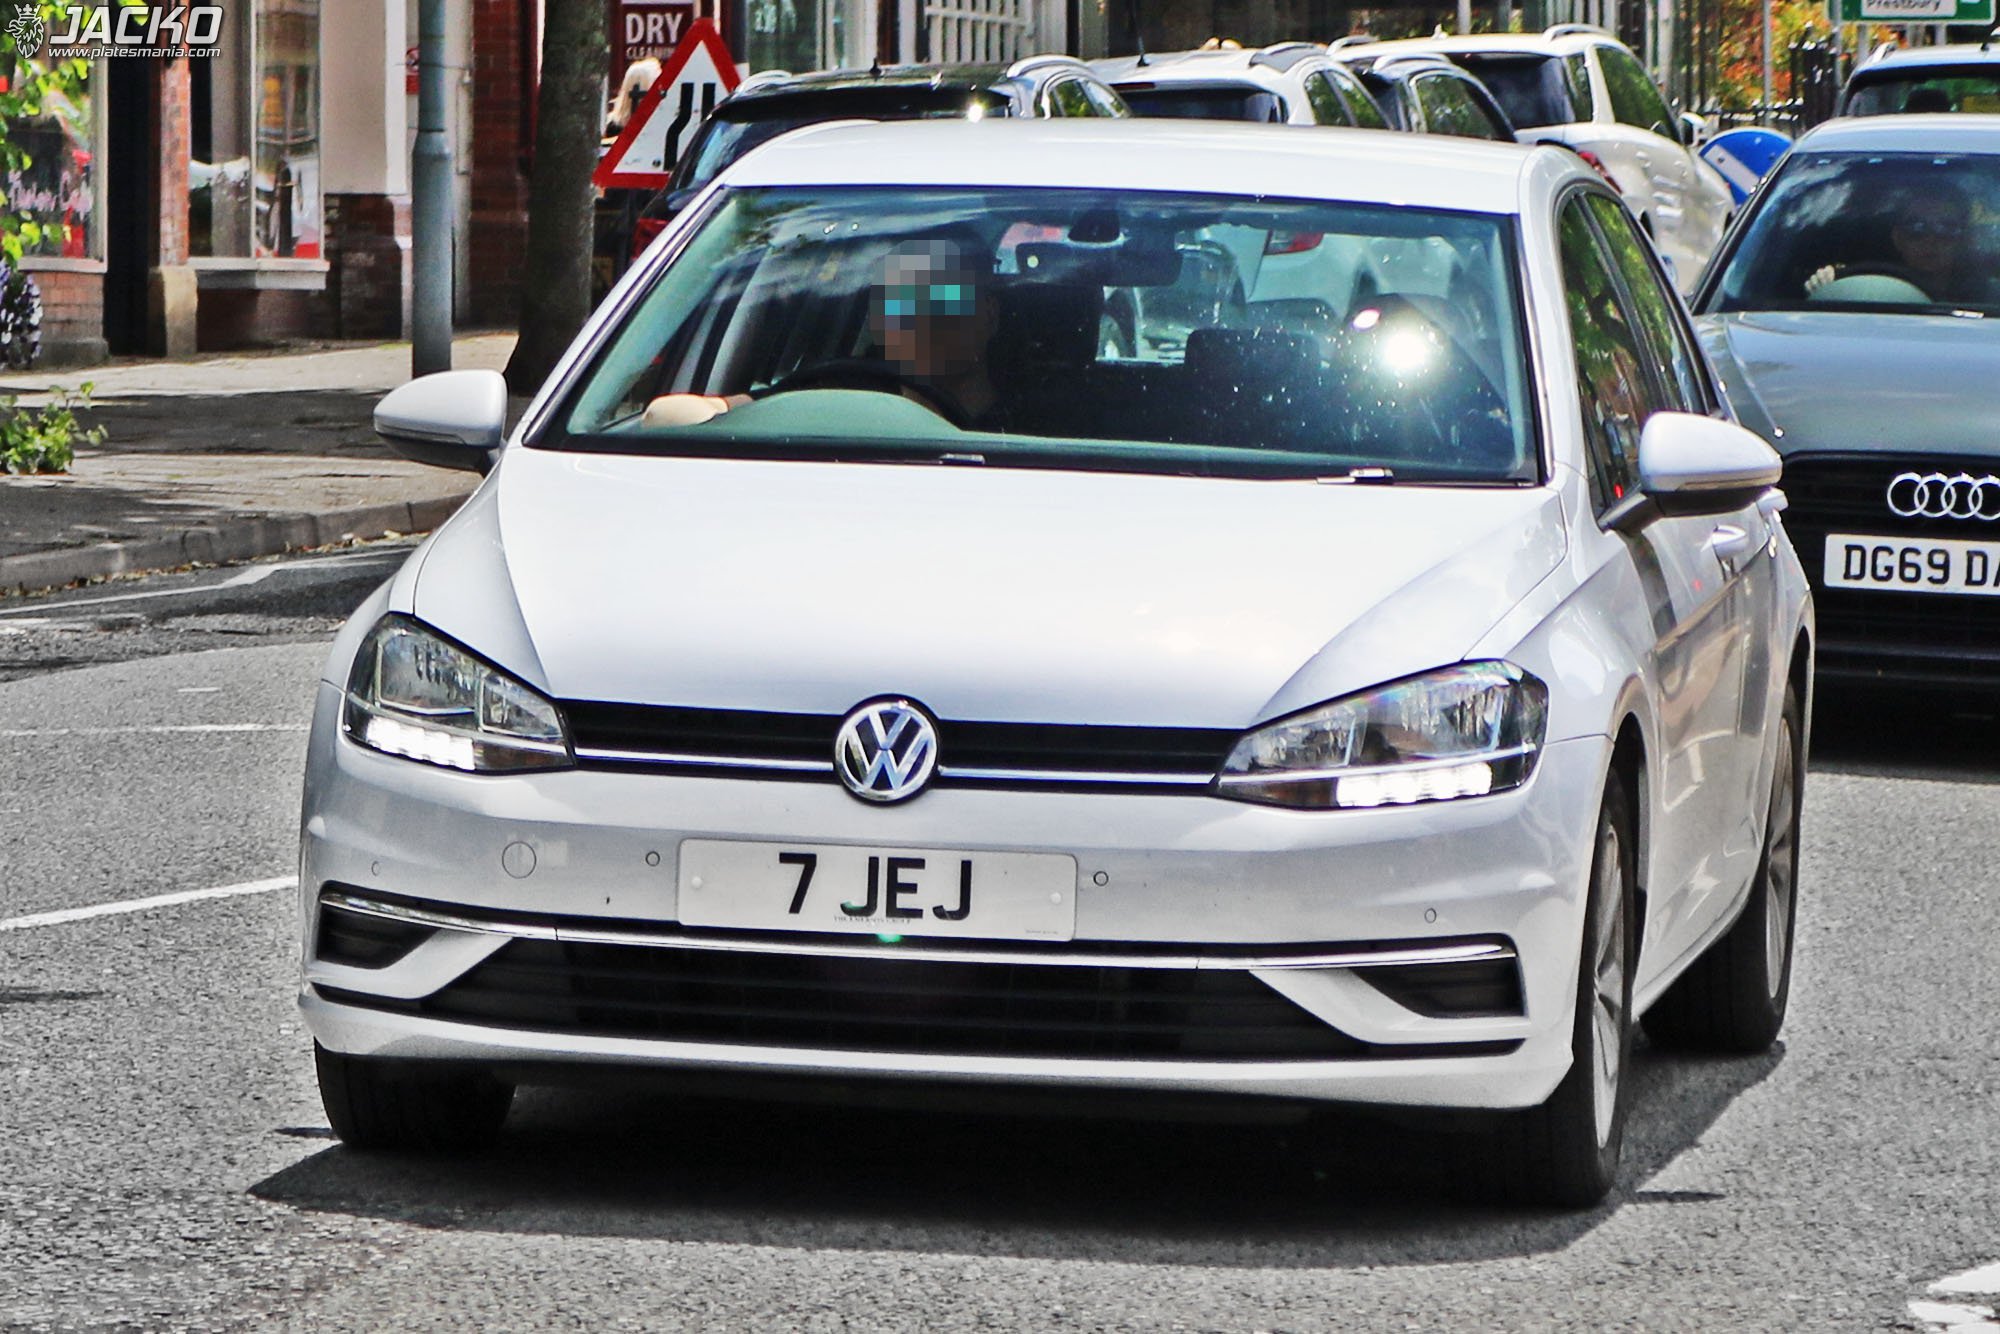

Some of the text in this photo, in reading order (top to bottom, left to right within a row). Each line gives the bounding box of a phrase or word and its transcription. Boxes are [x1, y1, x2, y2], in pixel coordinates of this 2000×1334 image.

[625, 12, 684, 45] DRY
[1843, 544, 1950, 585] DG69
[778, 852, 973, 921] 7 JEJ
